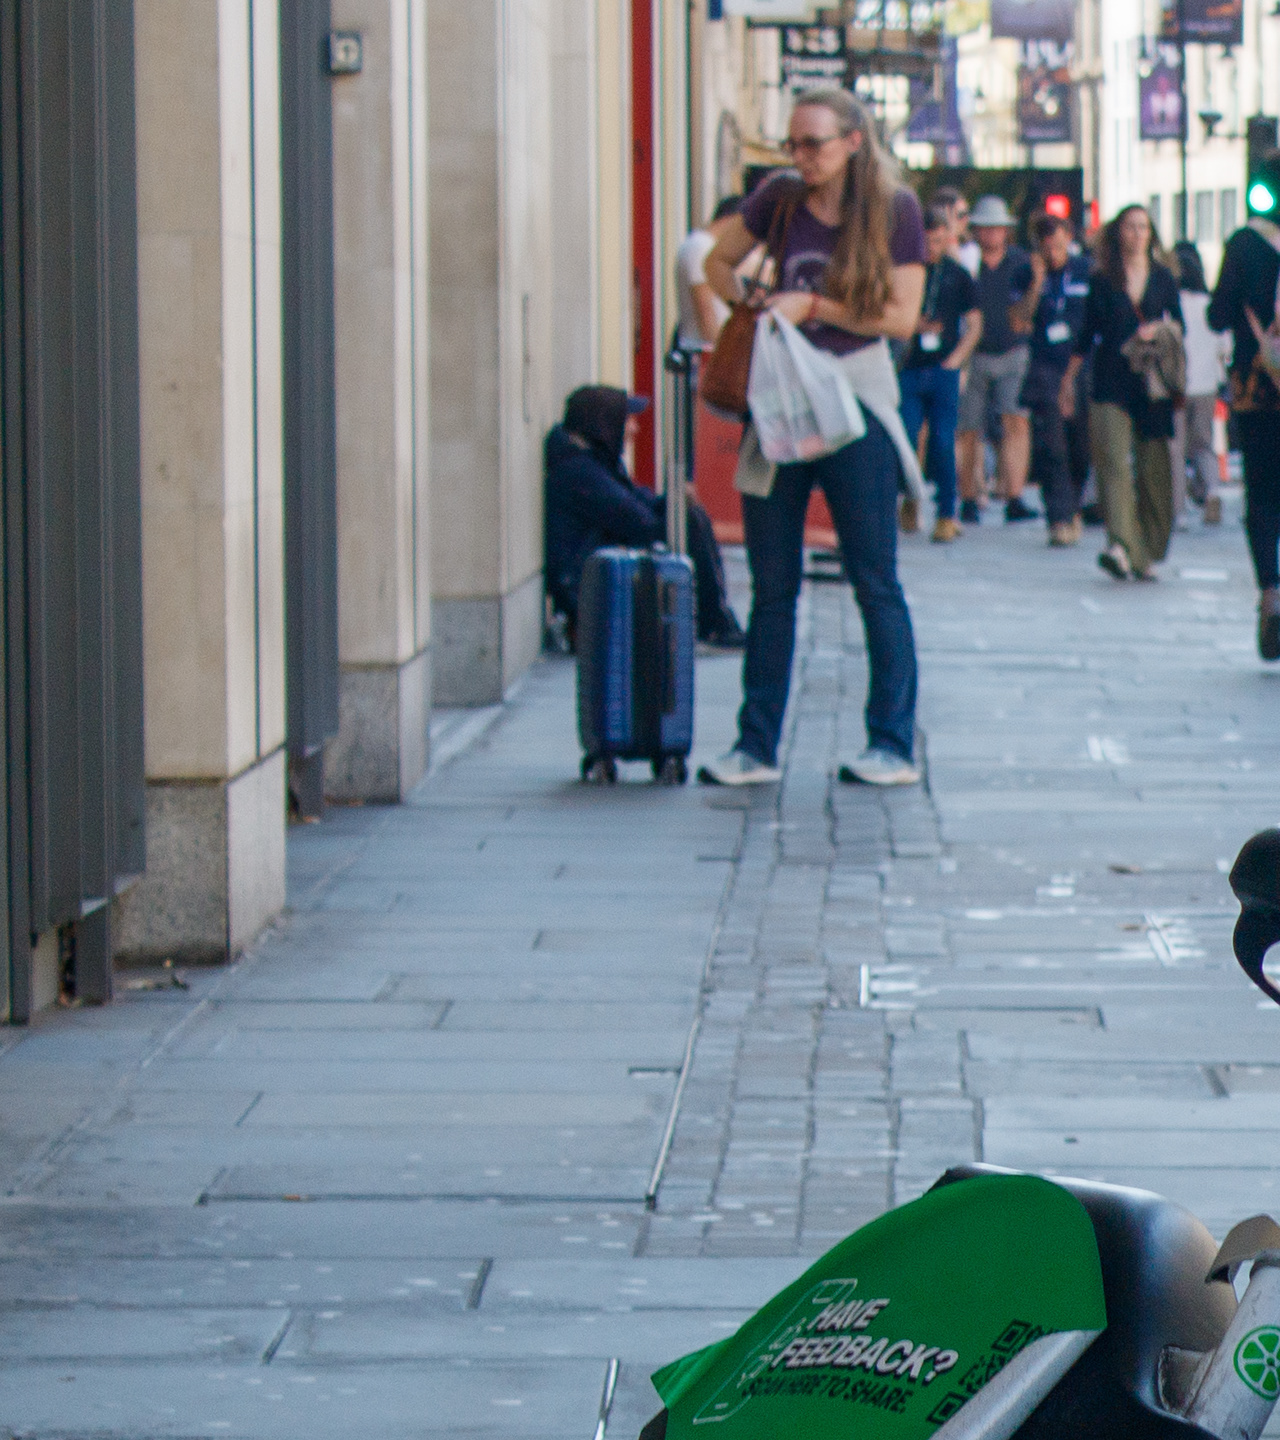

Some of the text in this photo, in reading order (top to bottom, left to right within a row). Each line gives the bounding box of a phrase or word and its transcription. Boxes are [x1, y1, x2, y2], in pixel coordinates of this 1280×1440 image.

[806, 1298, 890, 1331] HAVE
[771, 1335, 959, 1383] FEEDBACK?
[820, 1376, 851, 1398] TO
[843, 1379, 914, 1414] SHARE
